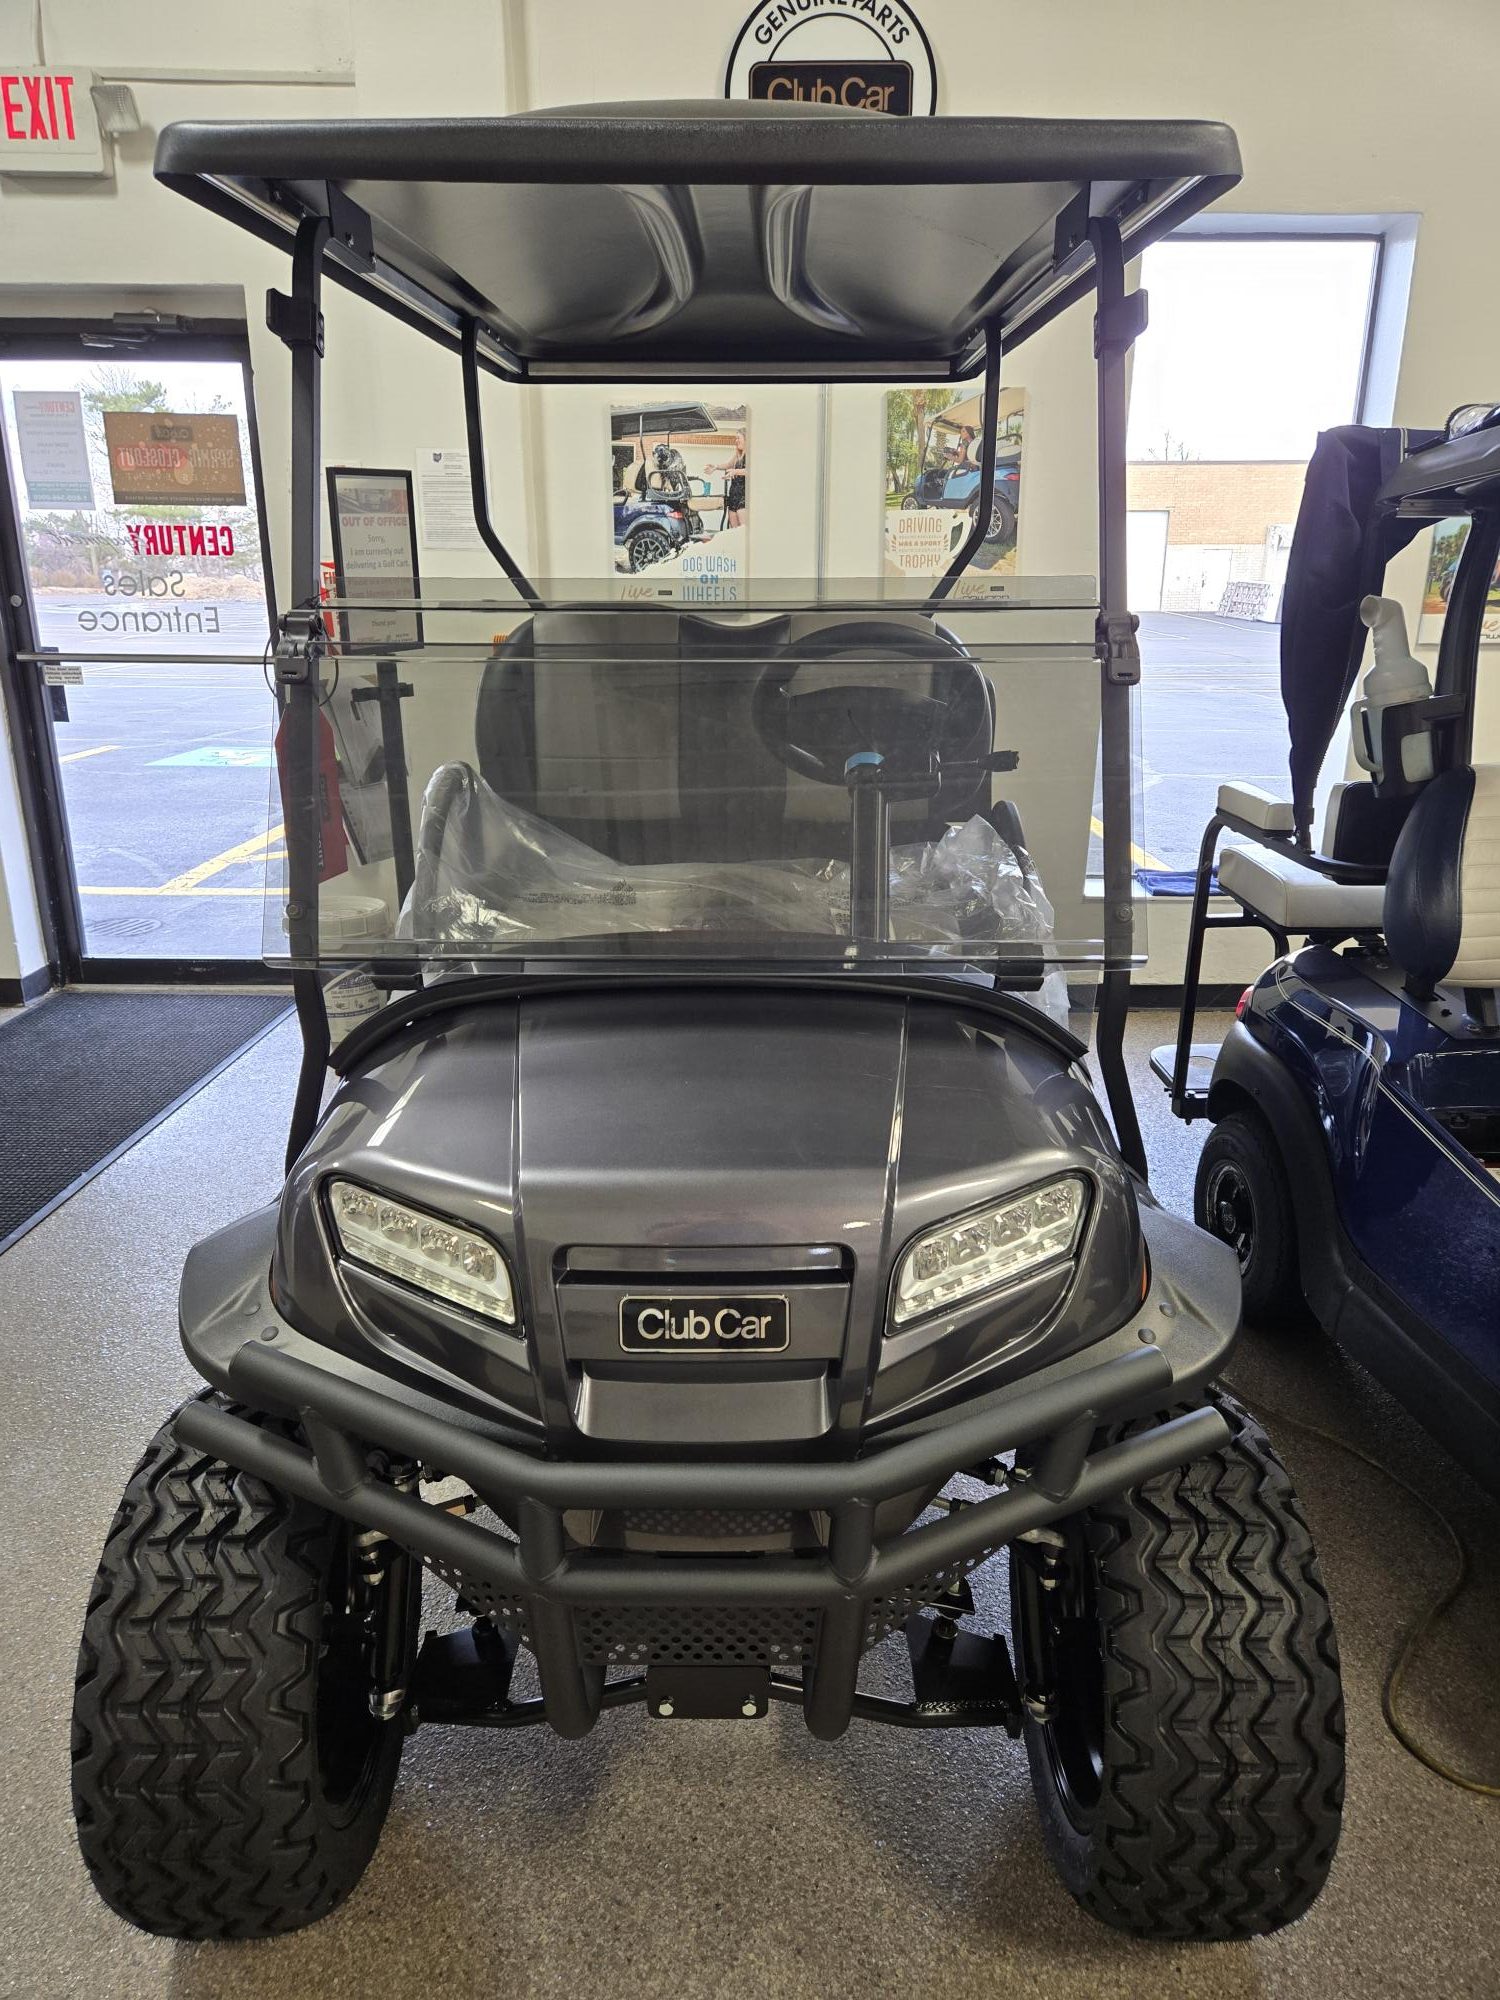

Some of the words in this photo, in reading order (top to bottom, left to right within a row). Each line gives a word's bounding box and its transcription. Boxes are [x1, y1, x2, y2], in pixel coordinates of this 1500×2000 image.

[754, 0, 848, 45] GENU
[767, 77, 836, 104] Club
[840, 77, 895, 111] Car
[0, 76, 75, 140] EXIT
[341, 516, 360, 527] OUT
[363, 516, 375, 526] OF
[377, 516, 408, 527] OFFICE
[899, 516, 942, 533] DRIVING
[682, 556, 702, 572] DOG
[706, 555, 736, 572] WASH
[899, 553, 941, 568] TROPHY
[699, 574, 719, 584] ON
[682, 585, 737, 601] WHEELS
[637, 1307, 711, 1340] Club
[714, 1307, 772, 1340] Car
